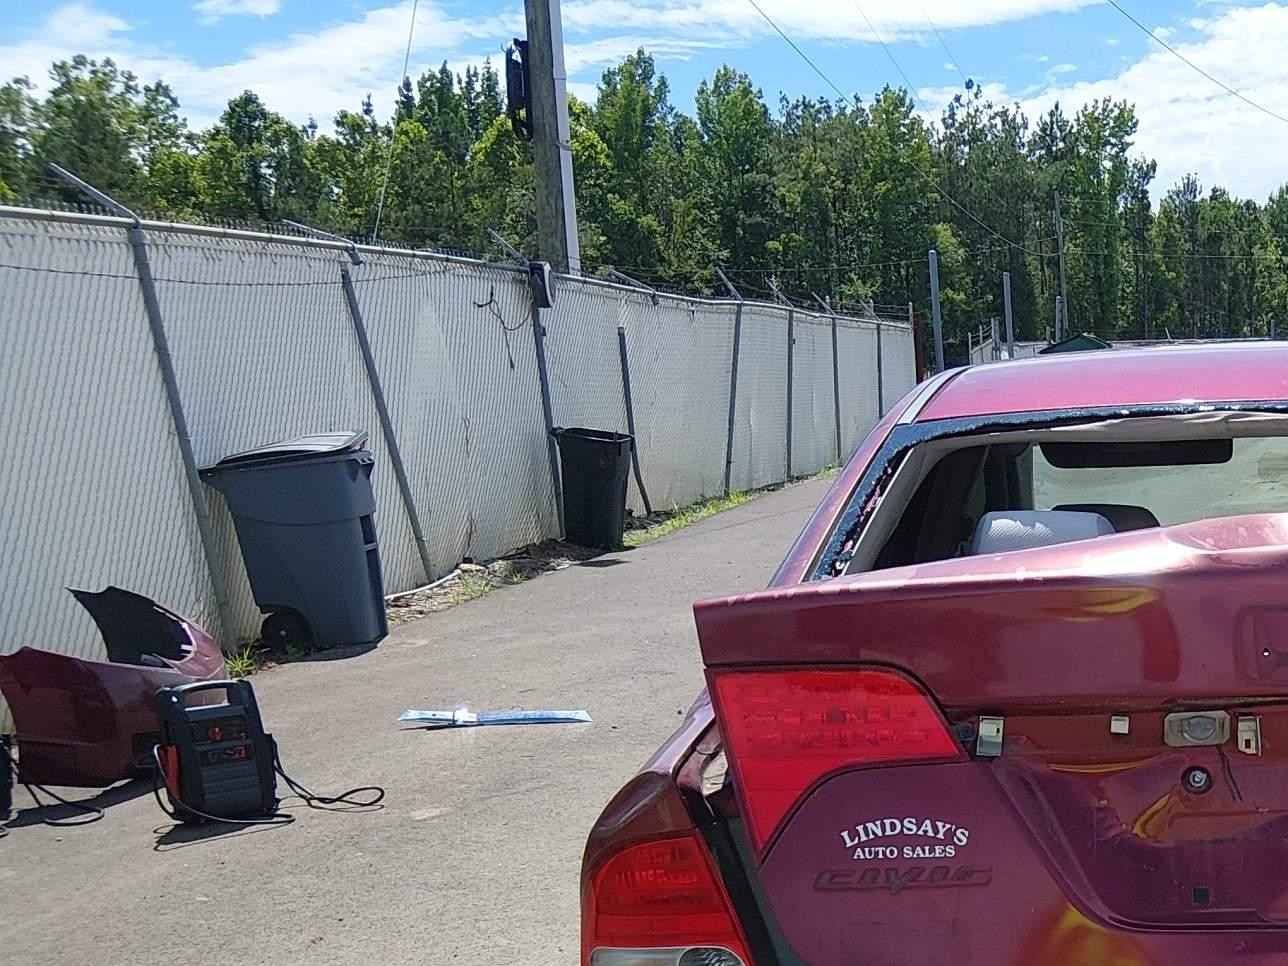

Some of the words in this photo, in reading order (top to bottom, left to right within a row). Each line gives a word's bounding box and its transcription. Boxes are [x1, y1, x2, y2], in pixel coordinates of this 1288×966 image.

[841, 817, 969, 847] LINDSAY'S
[853, 847, 898, 859] AUTO
[903, 845, 956, 859] SALES
